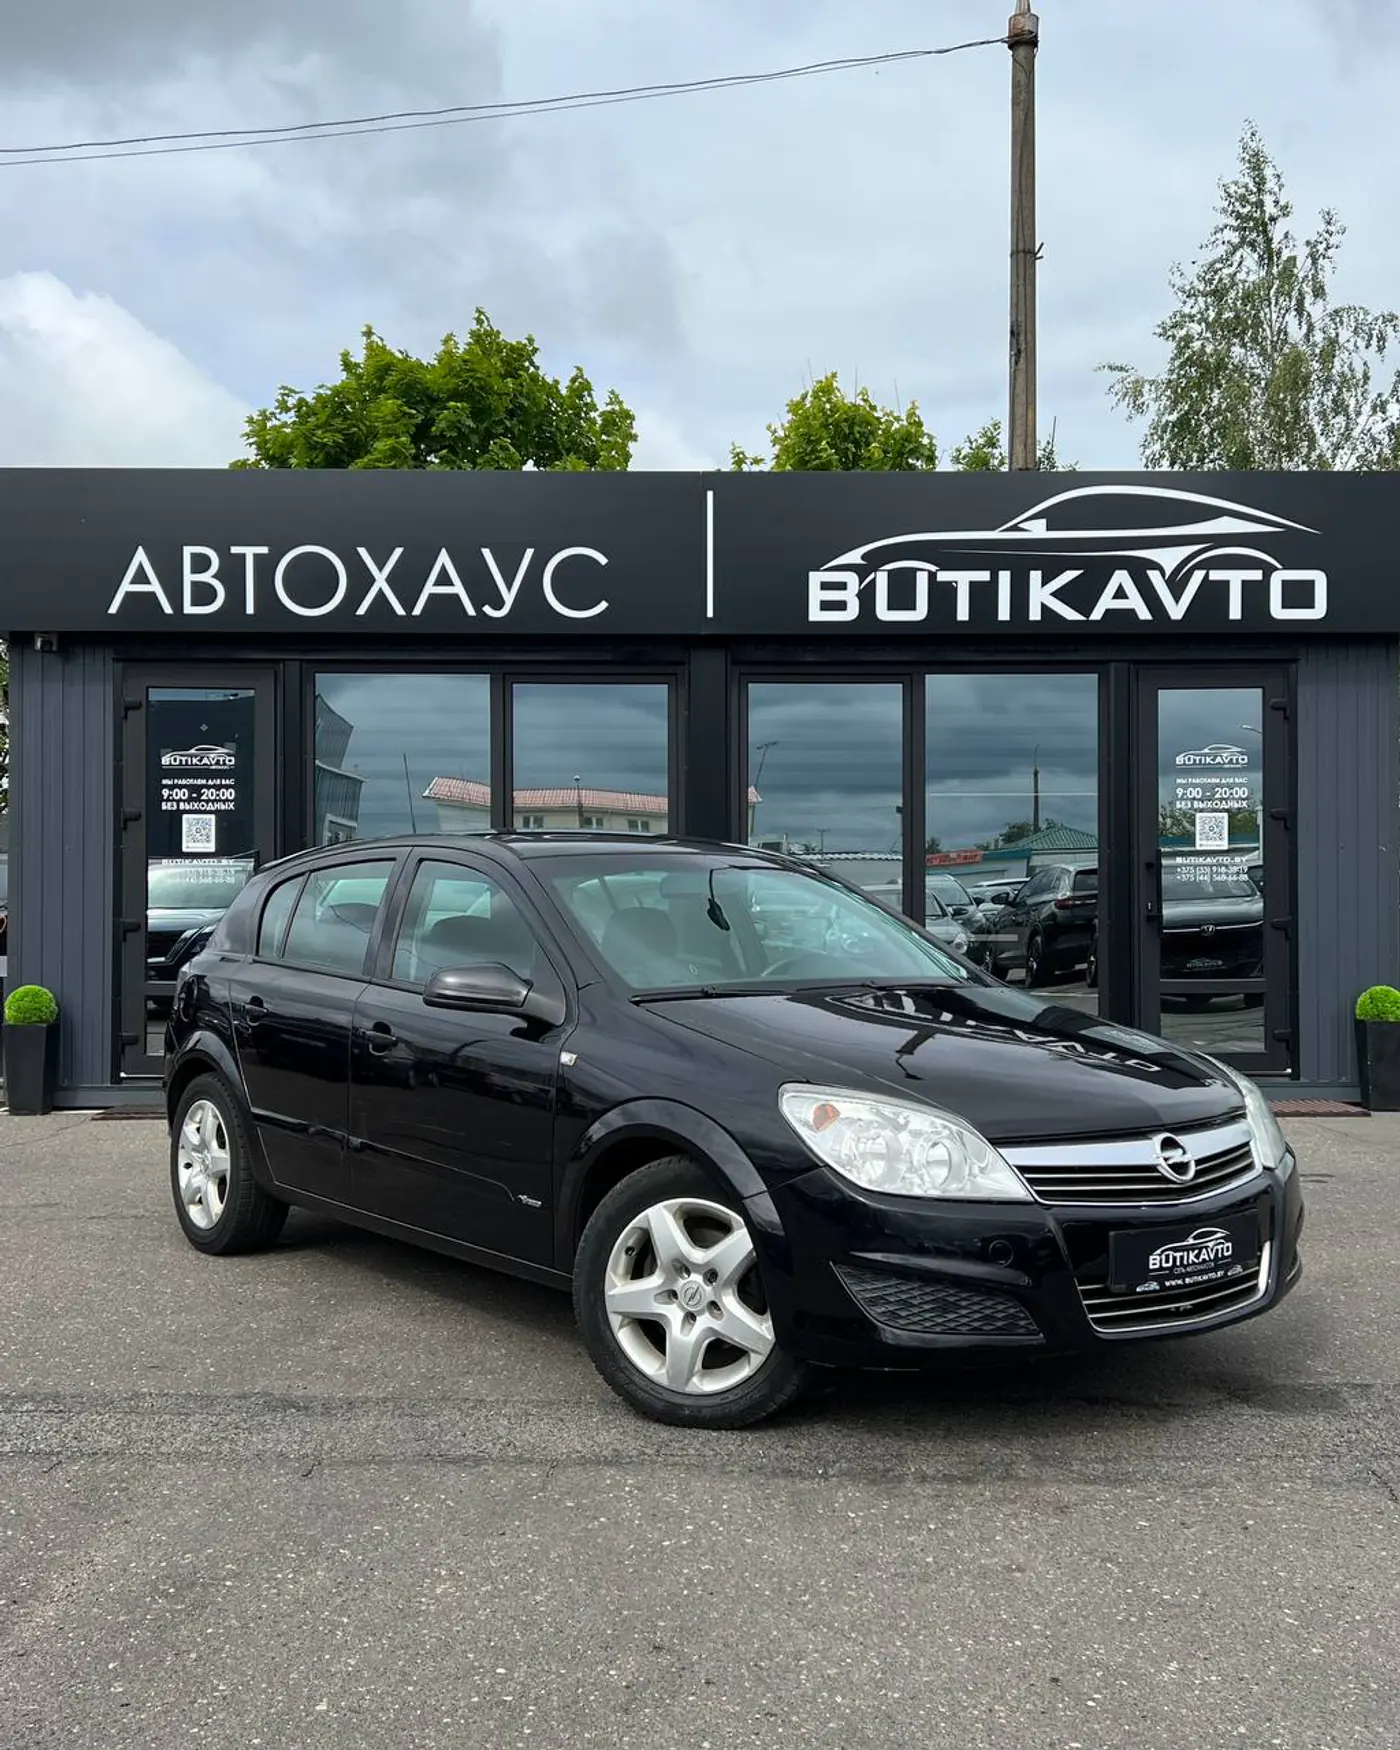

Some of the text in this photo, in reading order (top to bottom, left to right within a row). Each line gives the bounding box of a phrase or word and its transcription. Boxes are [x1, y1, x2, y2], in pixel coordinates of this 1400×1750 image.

[107, 544, 609, 619] АВТОХАУС
[808, 568, 1327, 622] BUTIKAVTO
[161, 756, 235, 766] BUTIKAVTO
[1176, 755, 1248, 764] BUTIKAVTO
[162, 788, 188, 800] 9:00
[200, 788, 235, 800] 20:00
[1176, 787, 1202, 798] 9:00
[1214, 787, 1248, 798] 20:00
[162, 802, 235, 811] БЕЗ ВЫХОДНЫХ
[1176, 800, 1248, 809] БЕЗ ВЫХОДНЫХ
[1149, 1242, 1232, 1269] BUTIKAVTO
